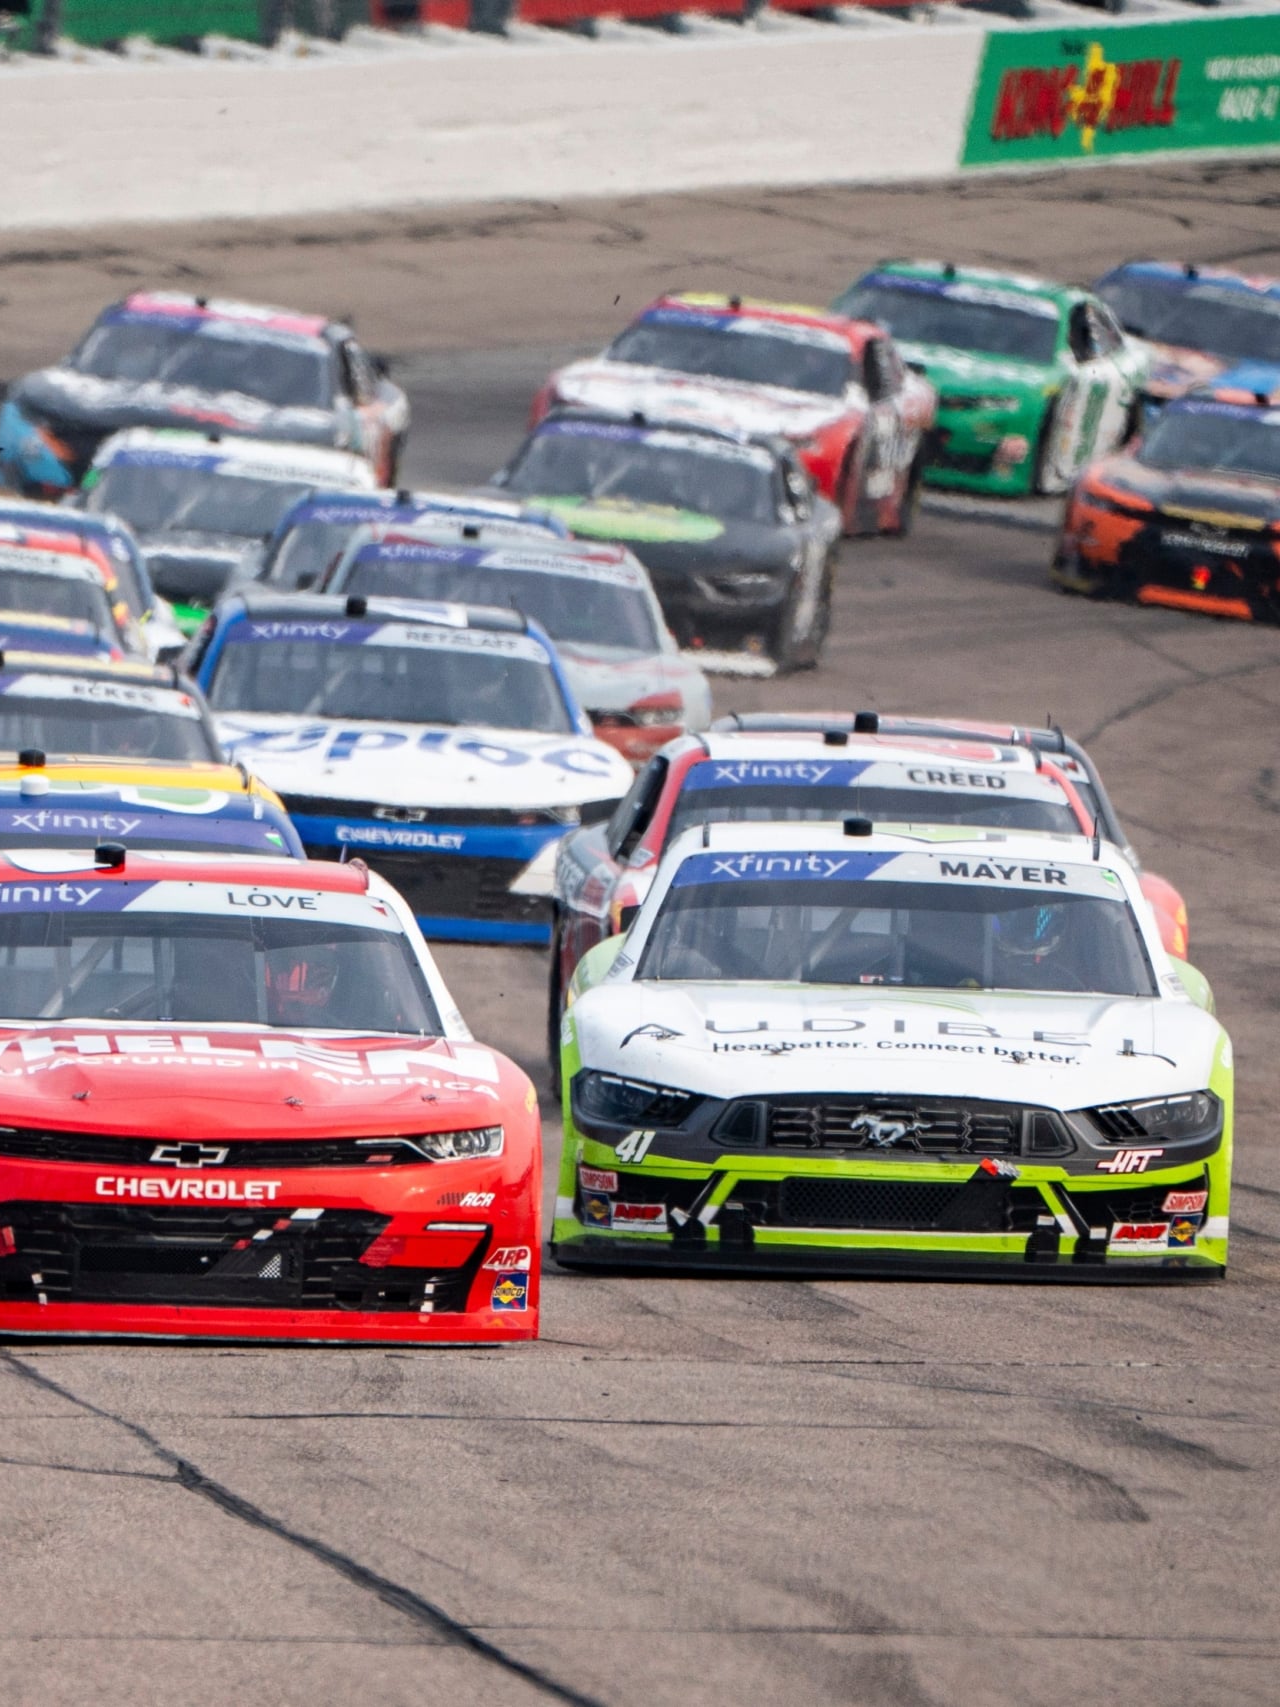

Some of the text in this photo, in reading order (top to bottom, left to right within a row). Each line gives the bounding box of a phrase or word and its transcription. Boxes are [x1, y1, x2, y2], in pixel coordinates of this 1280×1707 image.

[251, 622, 349, 642] xfinity
[72, 684, 155, 704] ECKES
[714, 762, 1007, 790] xfinity CREED
[10, 810, 144, 836] xfinity
[710, 854, 1068, 886] xfinity MAYER
[228, 891, 319, 912] LOVE
[712, 1040, 1081, 1066] Hear better. Connect better.
[259, 1060, 299, 1071] IN
[311, 1070, 500, 1100] AMERICA
[614, 1129, 657, 1164] 41
[95, 1176, 283, 1200] CHEVROLET
[459, 1191, 497, 1207] RCR
[486, 1248, 529, 1267] ARP
